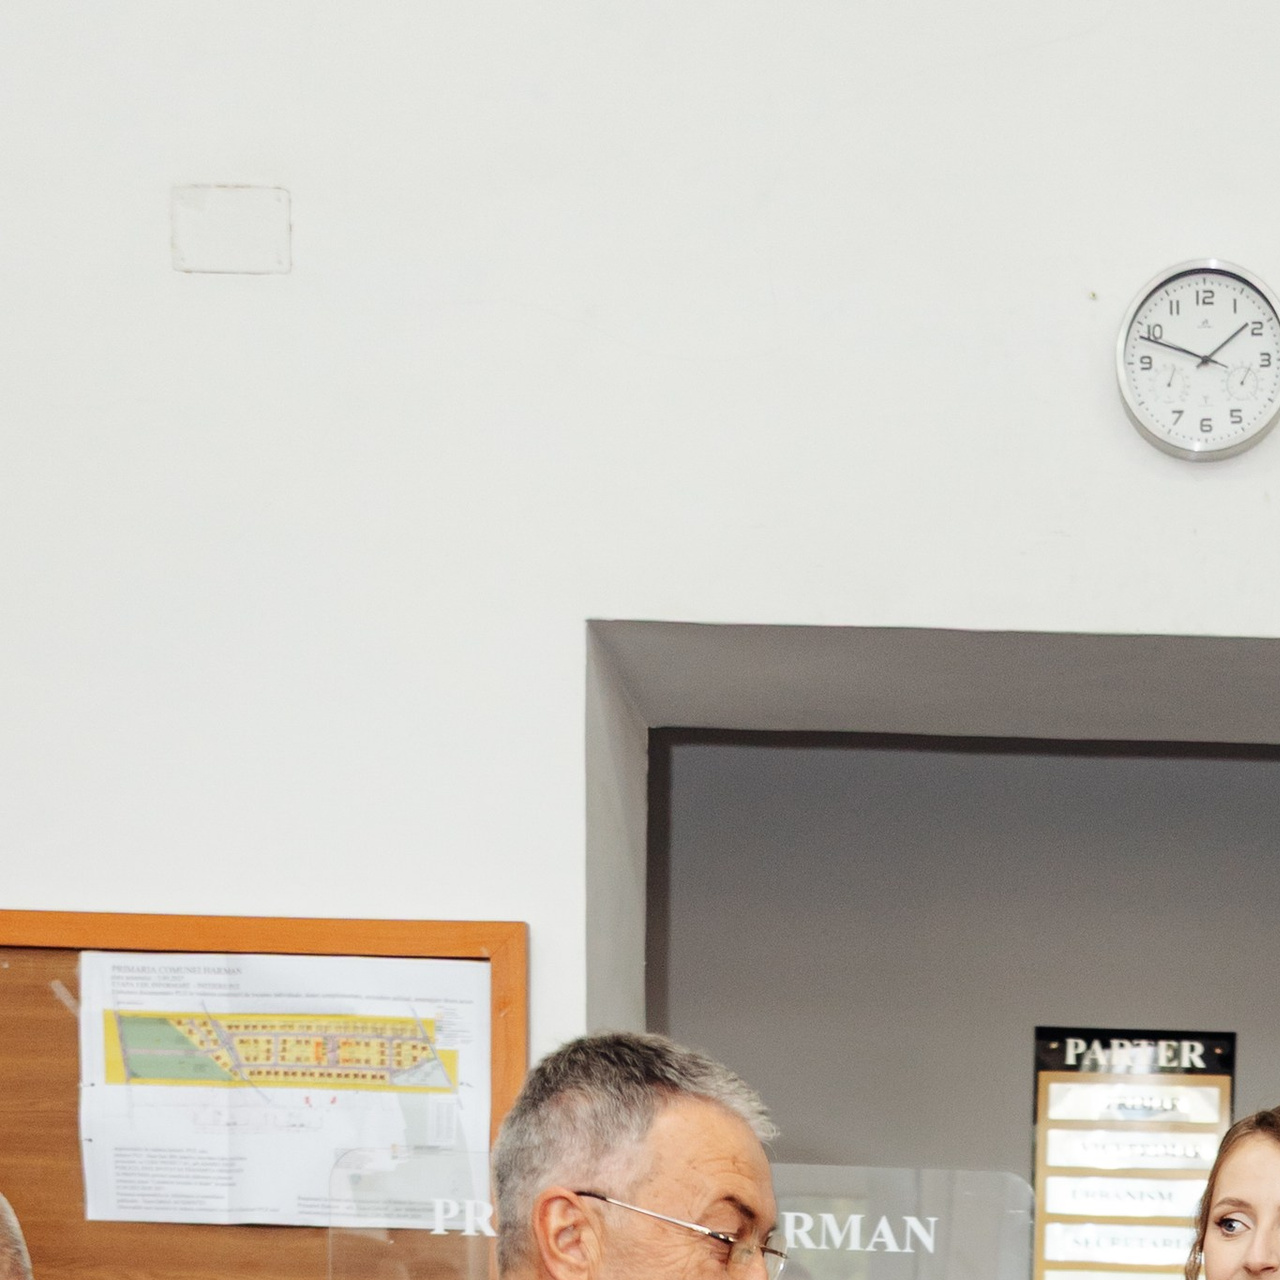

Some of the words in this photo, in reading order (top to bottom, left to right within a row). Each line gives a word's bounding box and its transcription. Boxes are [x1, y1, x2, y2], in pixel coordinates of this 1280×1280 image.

[1196, 290, 1215, 306] 12
[1169, 300, 1180, 316] 11
[1146, 323, 1163, 340] 10
[1251, 321, 1264, 336] 2
[1139, 355, 1153, 371] 9
[1259, 352, 1272, 368] 3
[1171, 410, 1184, 426] 7
[1229, 409, 1243, 424] 5
[1200, 418, 1213, 433] 6
[1064, 1038, 1207, 1069] PARTER
[781, 1211, 939, 1253] RMAN
